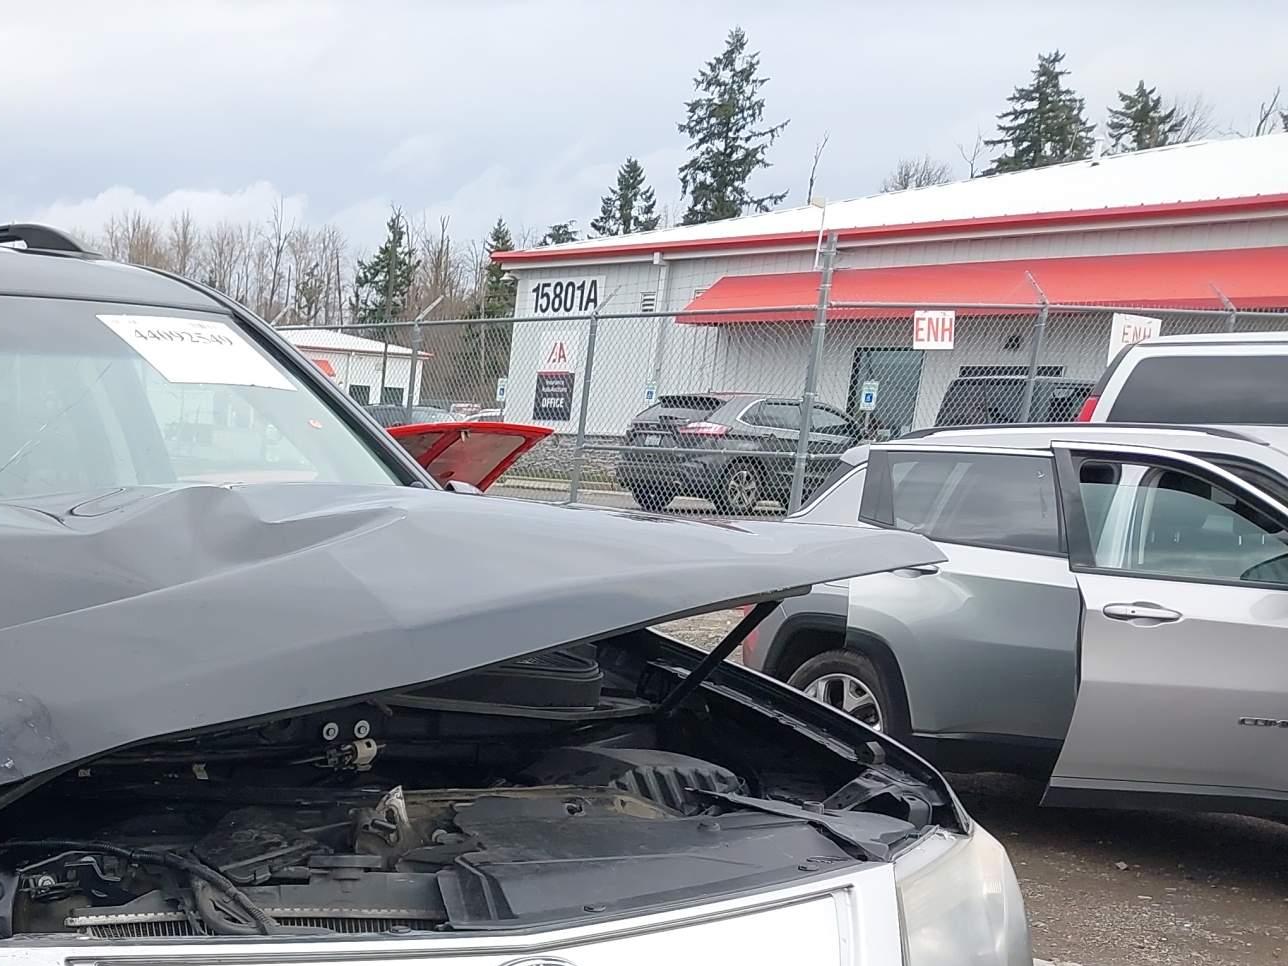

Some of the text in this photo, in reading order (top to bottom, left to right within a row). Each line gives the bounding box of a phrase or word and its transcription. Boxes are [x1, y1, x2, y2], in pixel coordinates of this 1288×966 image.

[531, 279, 598, 313] 15801A
[915, 316, 953, 342] ENH
[541, 397, 565, 408] OFFICE
